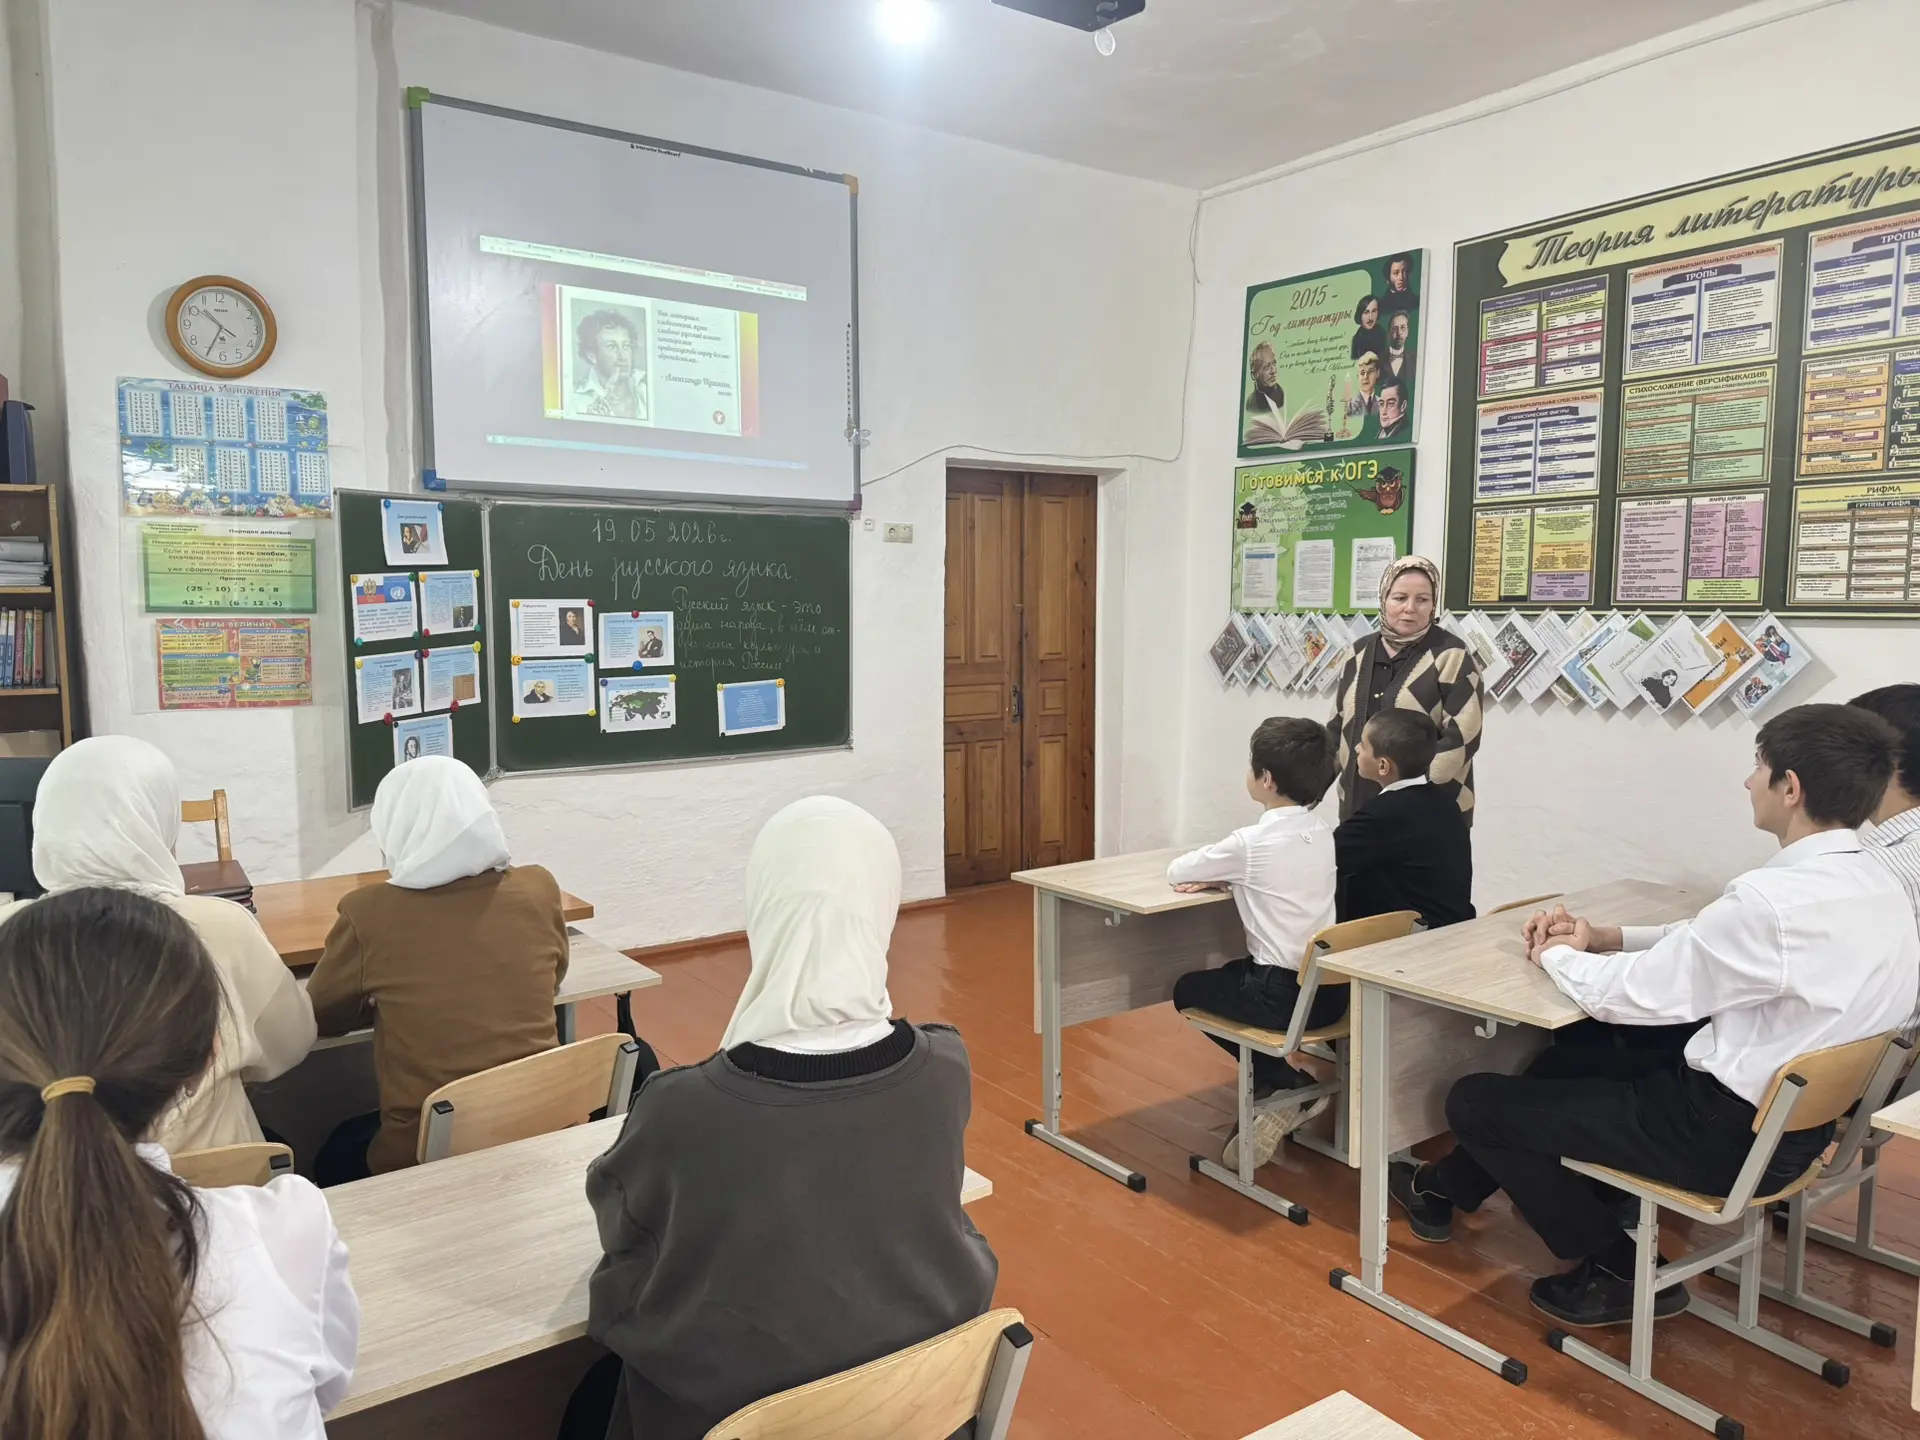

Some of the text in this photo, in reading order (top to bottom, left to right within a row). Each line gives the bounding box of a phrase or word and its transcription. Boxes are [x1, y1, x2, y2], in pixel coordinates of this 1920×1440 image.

[1524, 164, 1920, 271] Теория литературы
[1881, 231, 1920, 243] ТРОПЫ
[1685, 269, 1718, 281] ТРОПЫ
[202, 294, 206, 305] 11
[215, 292, 225, 303] 12
[235, 298, 239, 308] 1
[1290, 284, 1328, 311] 2015
[188, 305, 199, 316] 10
[246, 309, 253, 320] 2
[183, 319, 191, 329] 9
[1250, 308, 1353, 336] Год литературы
[253, 325, 259, 335] 3
[190, 335, 198, 345] 8
[246, 340, 253, 349] 4
[219, 351, 227, 361] 6
[236, 349, 242, 359] 5
[665, 373, 702, 386] Александр
[1629, 371, 1768, 395] СТИХОСЛОЖЕНИЕ (ВЕРСИФИКАЦИЯ)
[168, 382, 281, 398] ТАБЛИЦА УМНОЖЕНИЯ
[1240, 459, 1379, 492] Готовимся к ОГЭ
[1866, 485, 1901, 494] РИФМА
[527, 544, 594, 582] День
[611, 556, 714, 601] русского
[672, 586, 729, 622] Русский
[741, 600, 776, 624] язык
[792, 600, 822, 614] это
[742, 652, 783, 670] России
